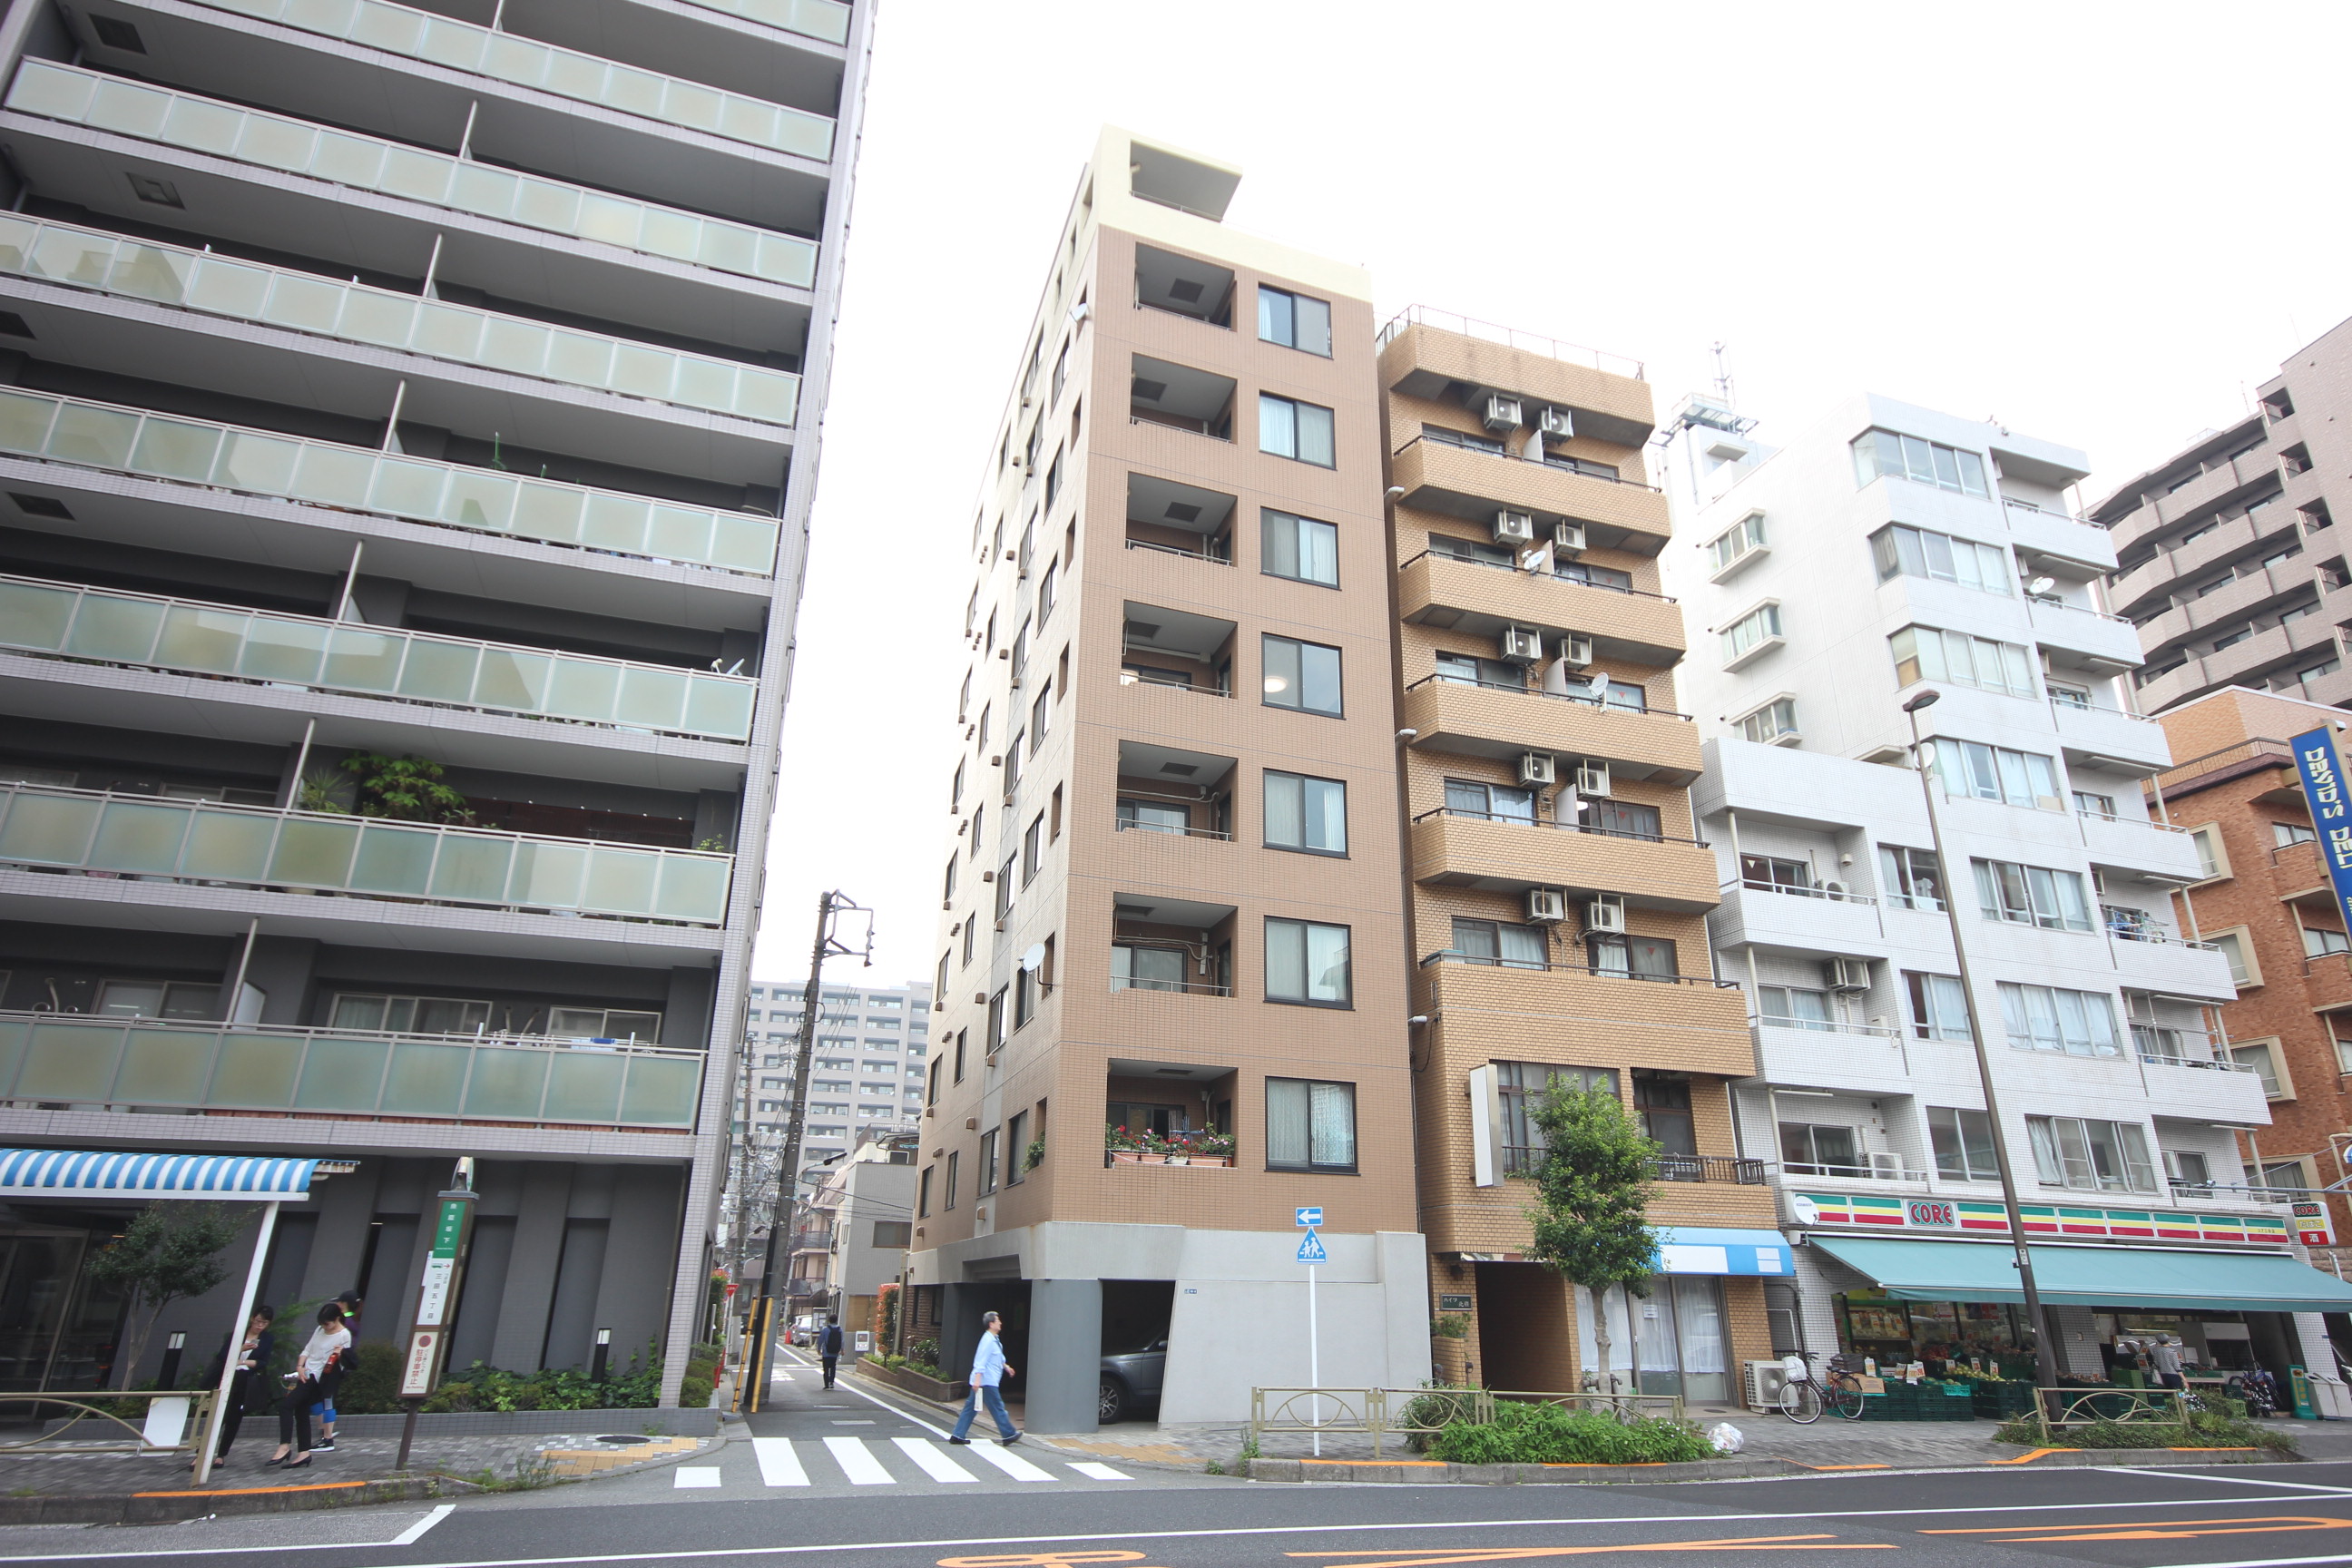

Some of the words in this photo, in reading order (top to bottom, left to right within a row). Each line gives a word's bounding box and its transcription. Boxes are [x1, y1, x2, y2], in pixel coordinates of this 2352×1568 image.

[2304, 746, 2345, 819] DAVID'S
[1911, 1203, 1953, 1224] CORE
[2294, 1205, 2320, 1215] CORE
[2308, 1233, 2319, 1243] 酒
